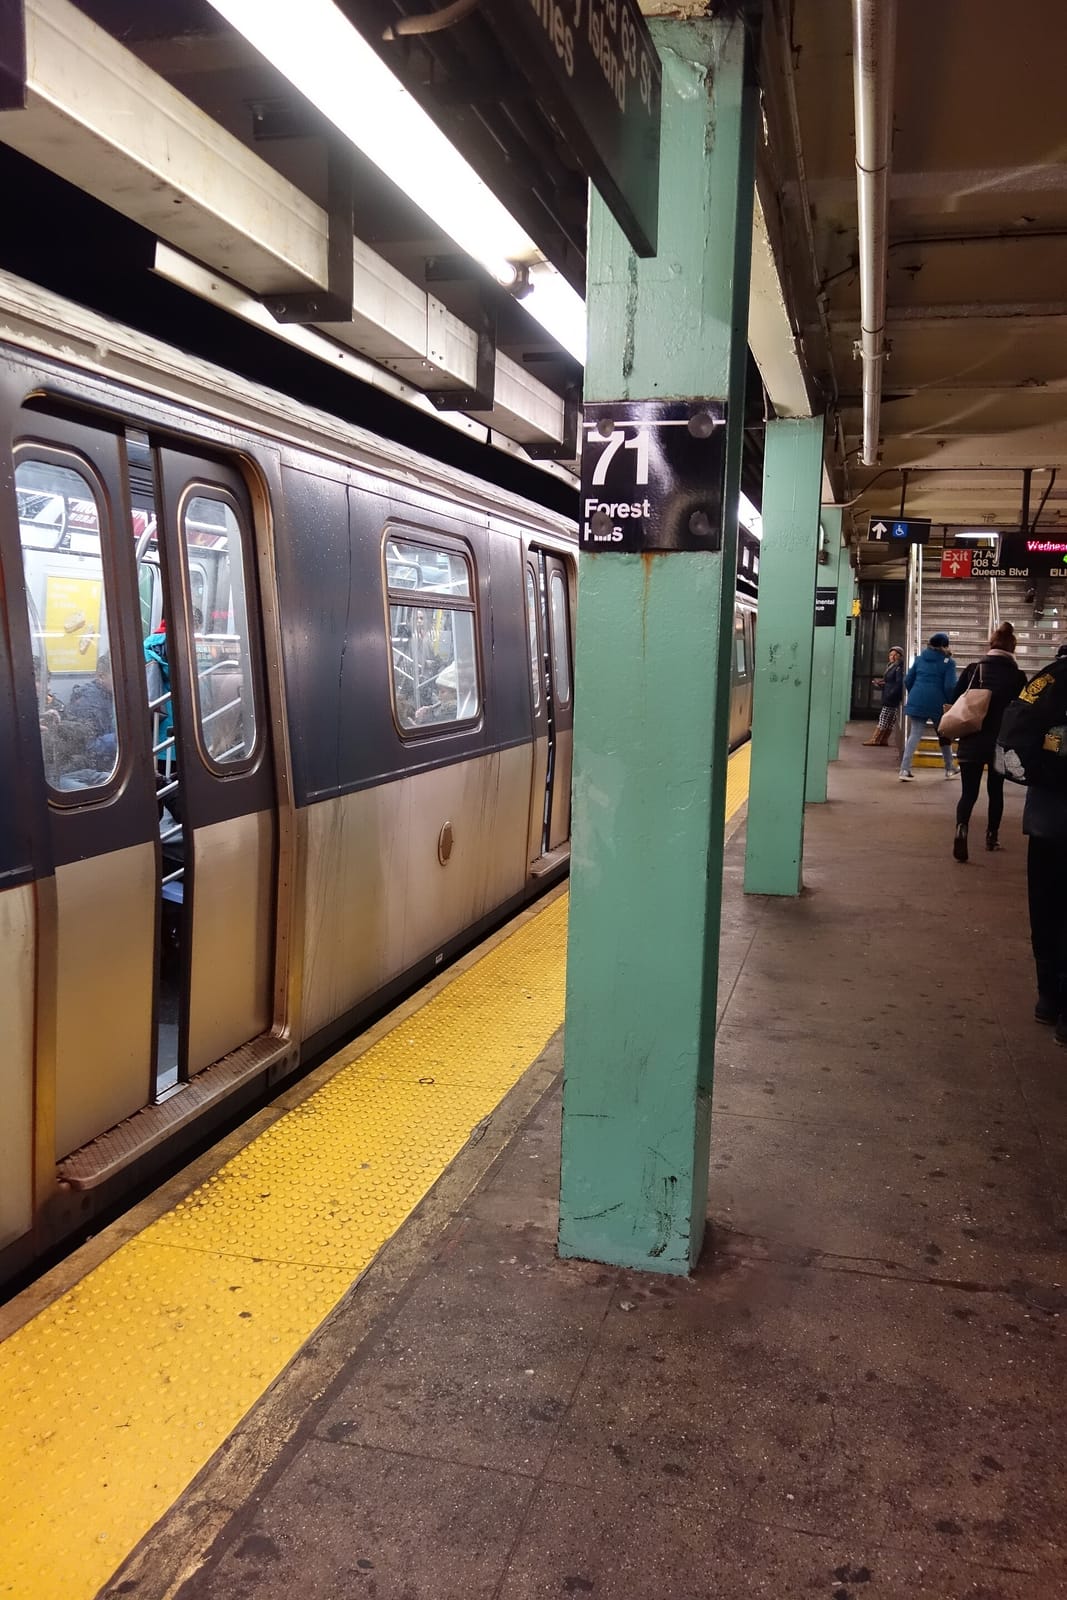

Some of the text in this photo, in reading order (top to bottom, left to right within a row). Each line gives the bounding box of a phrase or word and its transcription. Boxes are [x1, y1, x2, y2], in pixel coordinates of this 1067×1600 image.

[588, 0, 626, 114] Island
[621, 4, 651, 116] 63 St
[587, 430, 649, 486] 71
[584, 498, 651, 519] Forest
[1027, 541, 1067, 551] Wednes
[942, 551, 969, 561] Exit
[972, 550, 983, 558] 71
[972, 559, 989, 567] 108
[971, 567, 1029, 576] Queens Blvd
